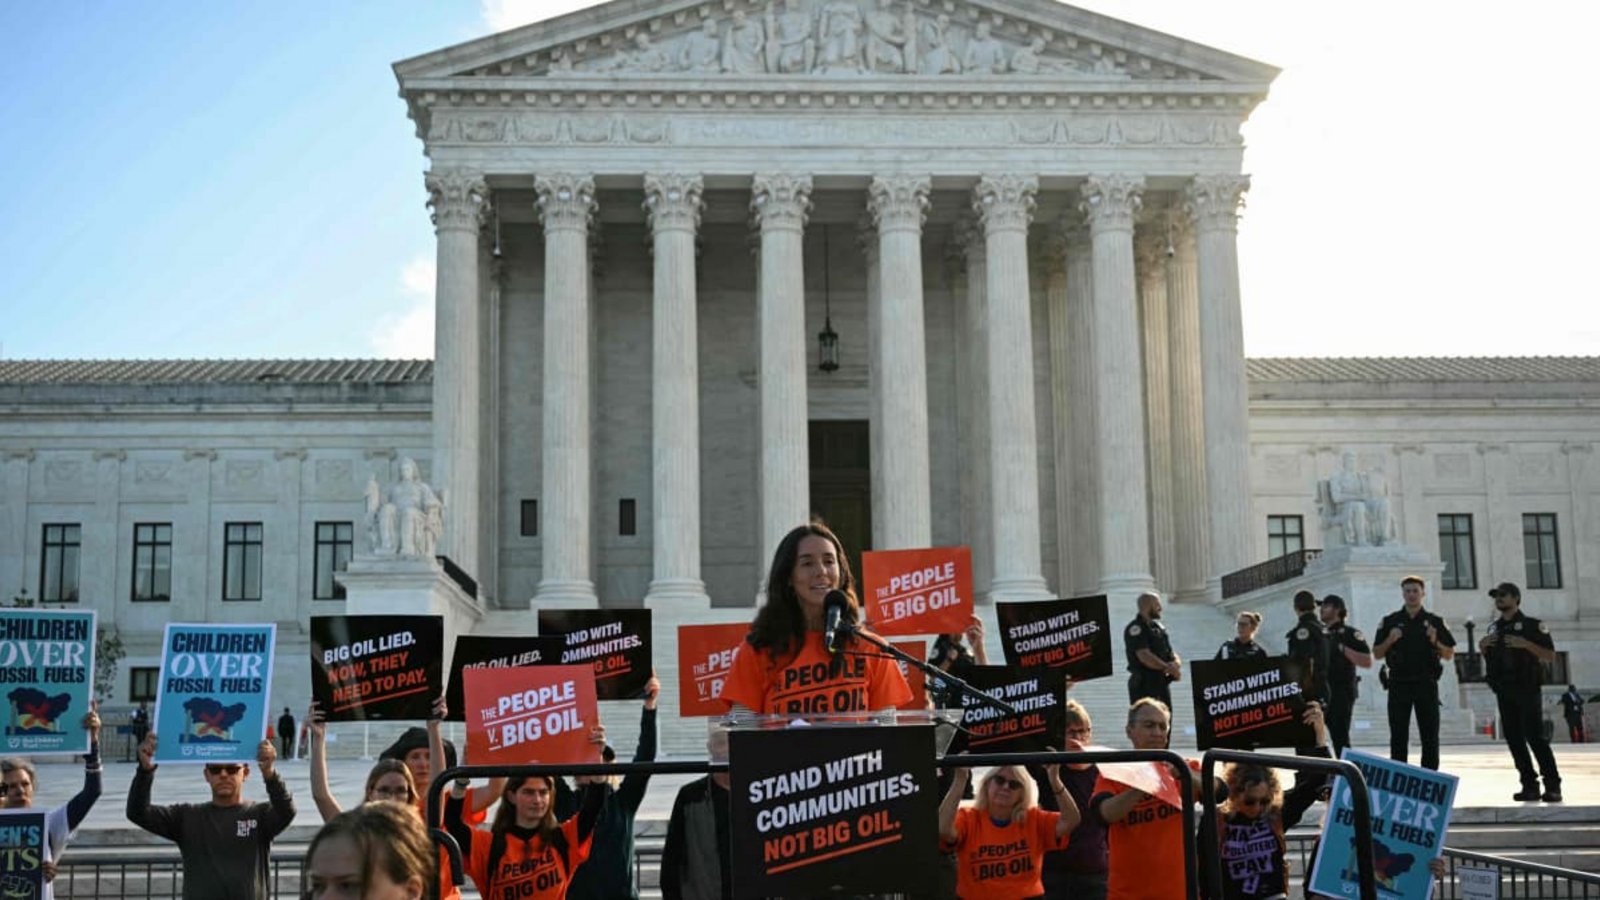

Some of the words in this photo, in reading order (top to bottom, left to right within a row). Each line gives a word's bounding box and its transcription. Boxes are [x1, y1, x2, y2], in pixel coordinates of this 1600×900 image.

[890, 562, 955, 594] PEOPLE
[893, 595, 926, 620] BIG
[929, 586, 961, 609] OIL
[589, 621, 622, 640] WITH
[1009, 620, 1047, 639] STAND
[1047, 610, 1080, 630] WITH
[1014, 620, 1100, 653] COMMUNITIES.
[0, 640, 85, 667] OVER
[172, 632, 267, 653] CHILDREN
[324, 645, 350, 665] BIG
[351, 638, 377, 657] OIL
[379, 630, 417, 651] LIED.
[561, 634, 642, 664] OMMUNITIES.
[170, 653, 263, 678] OVER
[328, 661, 367, 684] NOW,
[369, 650, 409, 674] THEY
[1020, 653, 1043, 667] NOT
[0, 667, 39, 684] OSSIL
[43, 667, 86, 684] FUELS
[166, 678, 215, 694] FOSSIL
[220, 678, 262, 694] FUELS
[333, 681, 372, 703] NEED
[374, 675, 395, 693] TO
[397, 668, 427, 688] PAY.
[1005, 678, 1038, 698] WITH
[1203, 679, 1245, 700] STAND
[1246, 669, 1280, 689] WITH
[481, 706, 498, 721] THE
[498, 680, 577, 716] PEOPLE
[833, 687, 866, 713] OIL
[1208, 681, 1303, 716] COMMUNITIES.
[487, 728, 499, 744] V.
[502, 717, 542, 748] BIG
[545, 708, 584, 736] OIL
[1213, 714, 1240, 732] NOT
[1241, 708, 1263, 725] BIG
[749, 766, 822, 804] STAND
[824, 748, 883, 784] WITH
[1355, 761, 1448, 806] HILDREN
[756, 772, 920, 833] COMMUNITIES.
[1128, 808, 1155, 826] BIG
[764, 831, 810, 863] NOT
[813, 820, 850, 850] BIG
[857, 809, 901, 837] OIL.
[979, 839, 1028, 858] PEOPLE
[1390, 821, 1436, 848] FUELS
[979, 862, 1007, 880] BIG
[1009, 855, 1035, 875] OIL
[503, 880, 534, 900] BIG
[536, 868, 563, 891] OIL
